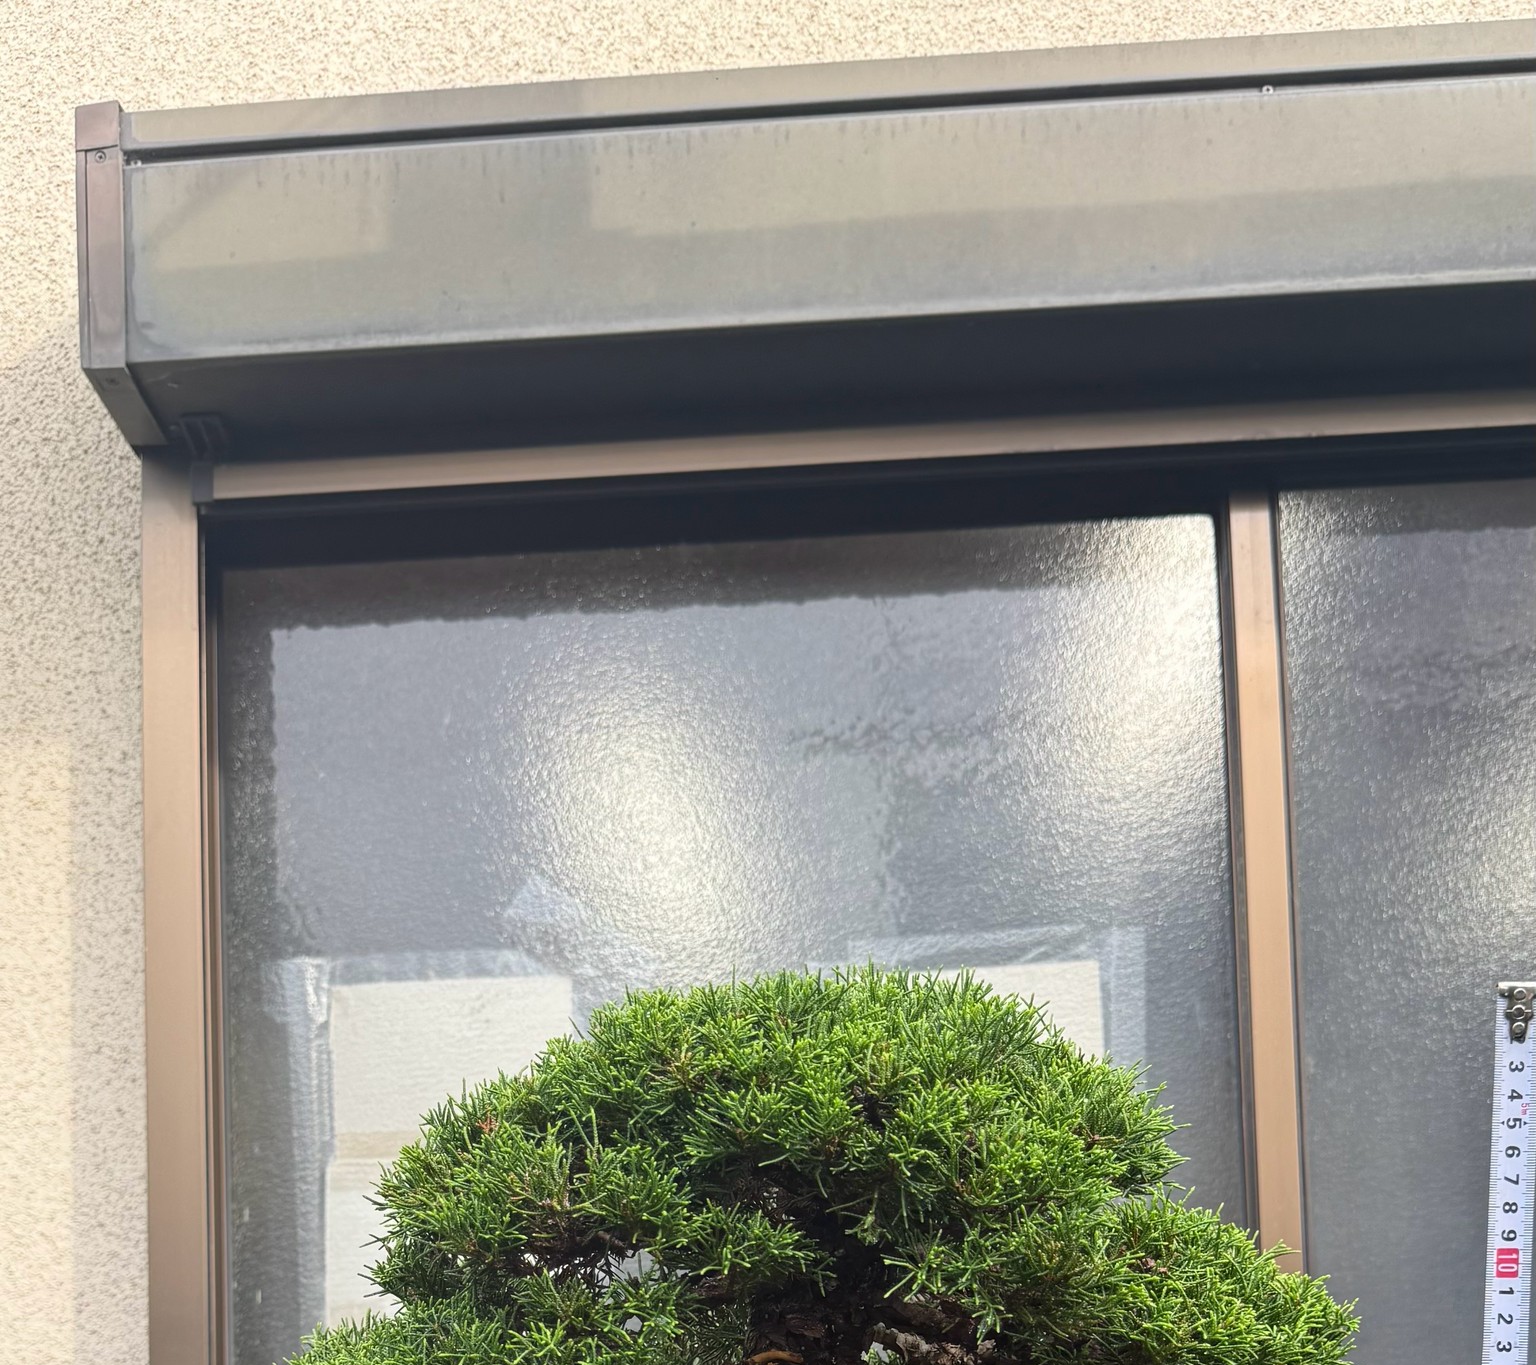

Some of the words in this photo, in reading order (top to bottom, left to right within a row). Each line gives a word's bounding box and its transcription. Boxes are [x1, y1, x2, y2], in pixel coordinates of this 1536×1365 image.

[1509, 1061, 1525, 1073] 3
[1507, 1089, 1523, 1102] 4
[1506, 1118, 1522, 1129] 5
[1505, 1146, 1521, 1158] 6
[1504, 1174, 1519, 1185] 7
[1503, 1202, 1518, 1214] 8
[1501, 1230, 1517, 1241] 9
[1498, 1253, 1518, 1272] 10
[1499, 1287, 1514, 1295] 1
[1497, 1313, 1513, 1324] 2
[1496, 1341, 1512, 1352] 3
